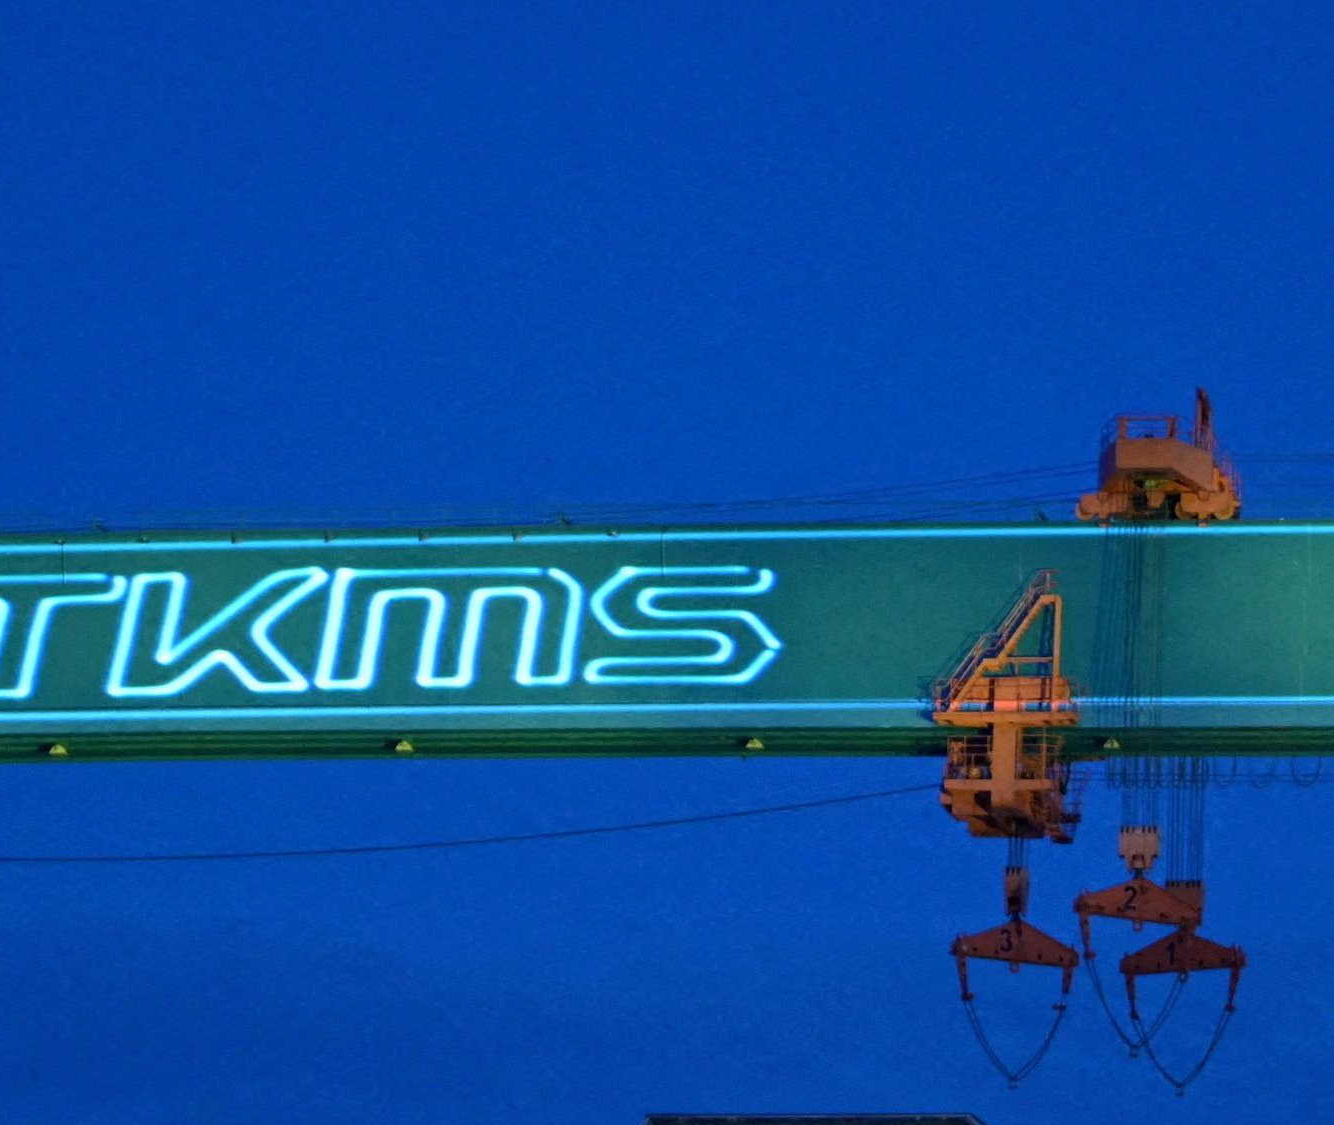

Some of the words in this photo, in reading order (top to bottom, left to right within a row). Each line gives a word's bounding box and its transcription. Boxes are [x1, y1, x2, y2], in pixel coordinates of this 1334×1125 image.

[1123, 885, 1138, 911] 2
[999, 928, 1013, 953] 3
[1166, 941, 1176, 966] 1
